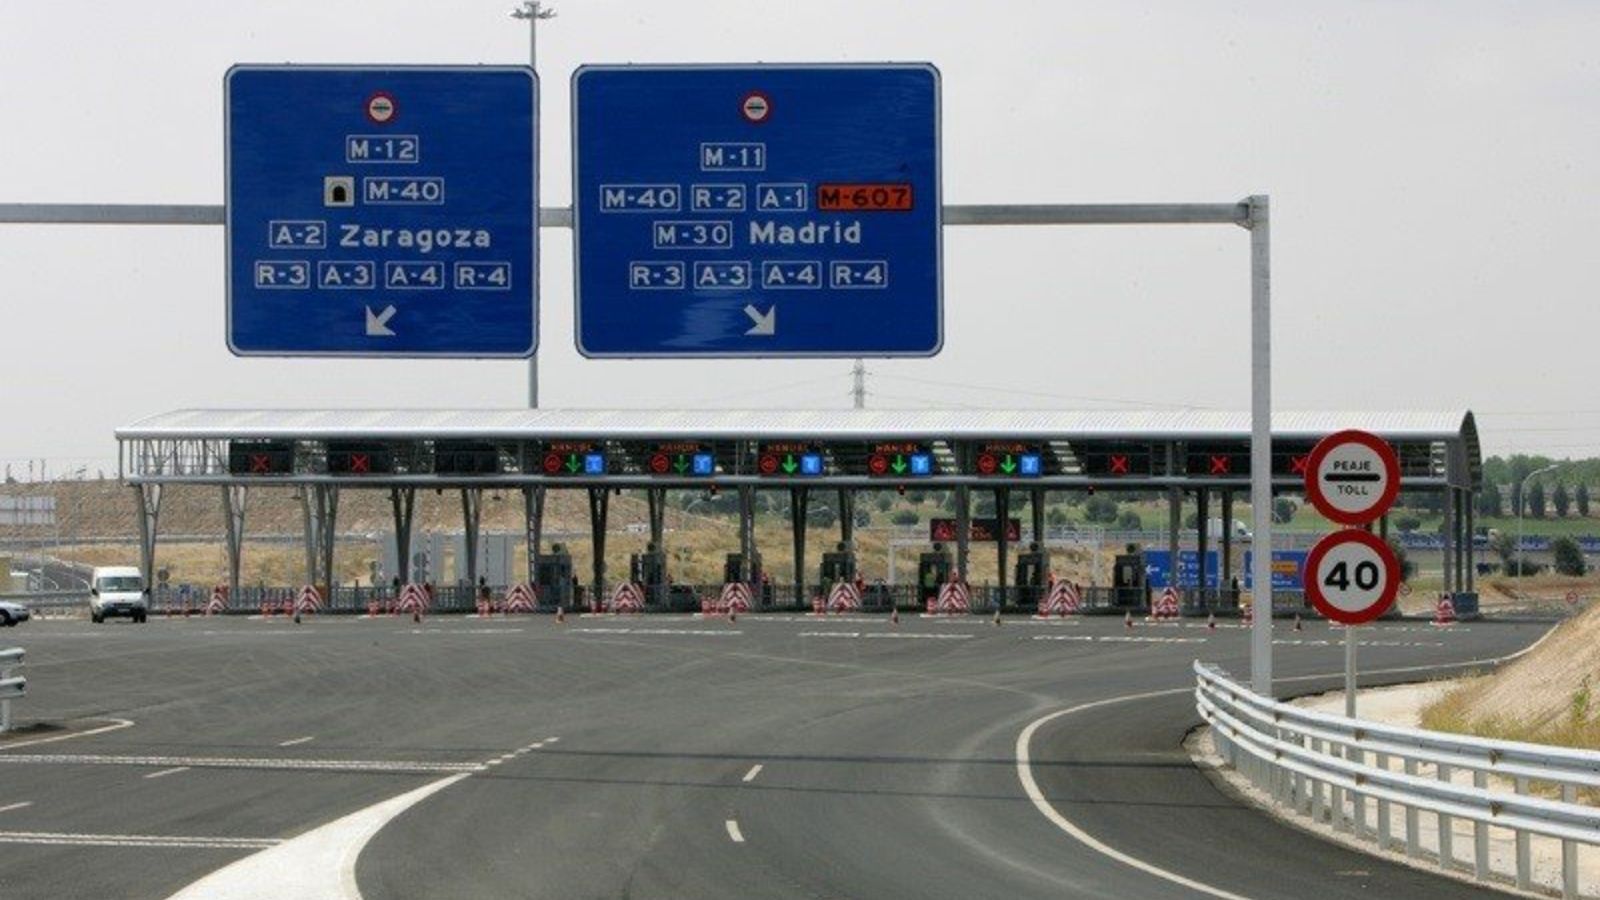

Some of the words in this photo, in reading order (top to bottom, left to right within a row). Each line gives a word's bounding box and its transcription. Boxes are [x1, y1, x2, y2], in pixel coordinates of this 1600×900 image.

[350, 139, 415, 159] M-12
[705, 147, 763, 166] M-11
[368, 181, 440, 200] M-40
[605, 189, 678, 208] M-40
[695, 189, 742, 208] R-2
[761, 188, 803, 207] A-1
[820, 187, 908, 207] M-607
[275, 225, 321, 244] A-2
[339, 224, 491, 253] Zaragoza
[657, 225, 728, 244] M-30
[750, 220, 861, 244] Madrid
[258, 265, 306, 285] R-3
[323, 265, 370, 285] A-3
[390, 266, 438, 285] A-4
[458, 266, 507, 286] R-4
[632, 265, 681, 285] R-3
[699, 265, 746, 285] A-3
[767, 265, 816, 285] A-4
[835, 265, 883, 285] R-4
[1333, 460, 1372, 472] PEAJE
[1337, 484, 1369, 496] TOLL
[1323, 560, 1380, 592] 40
